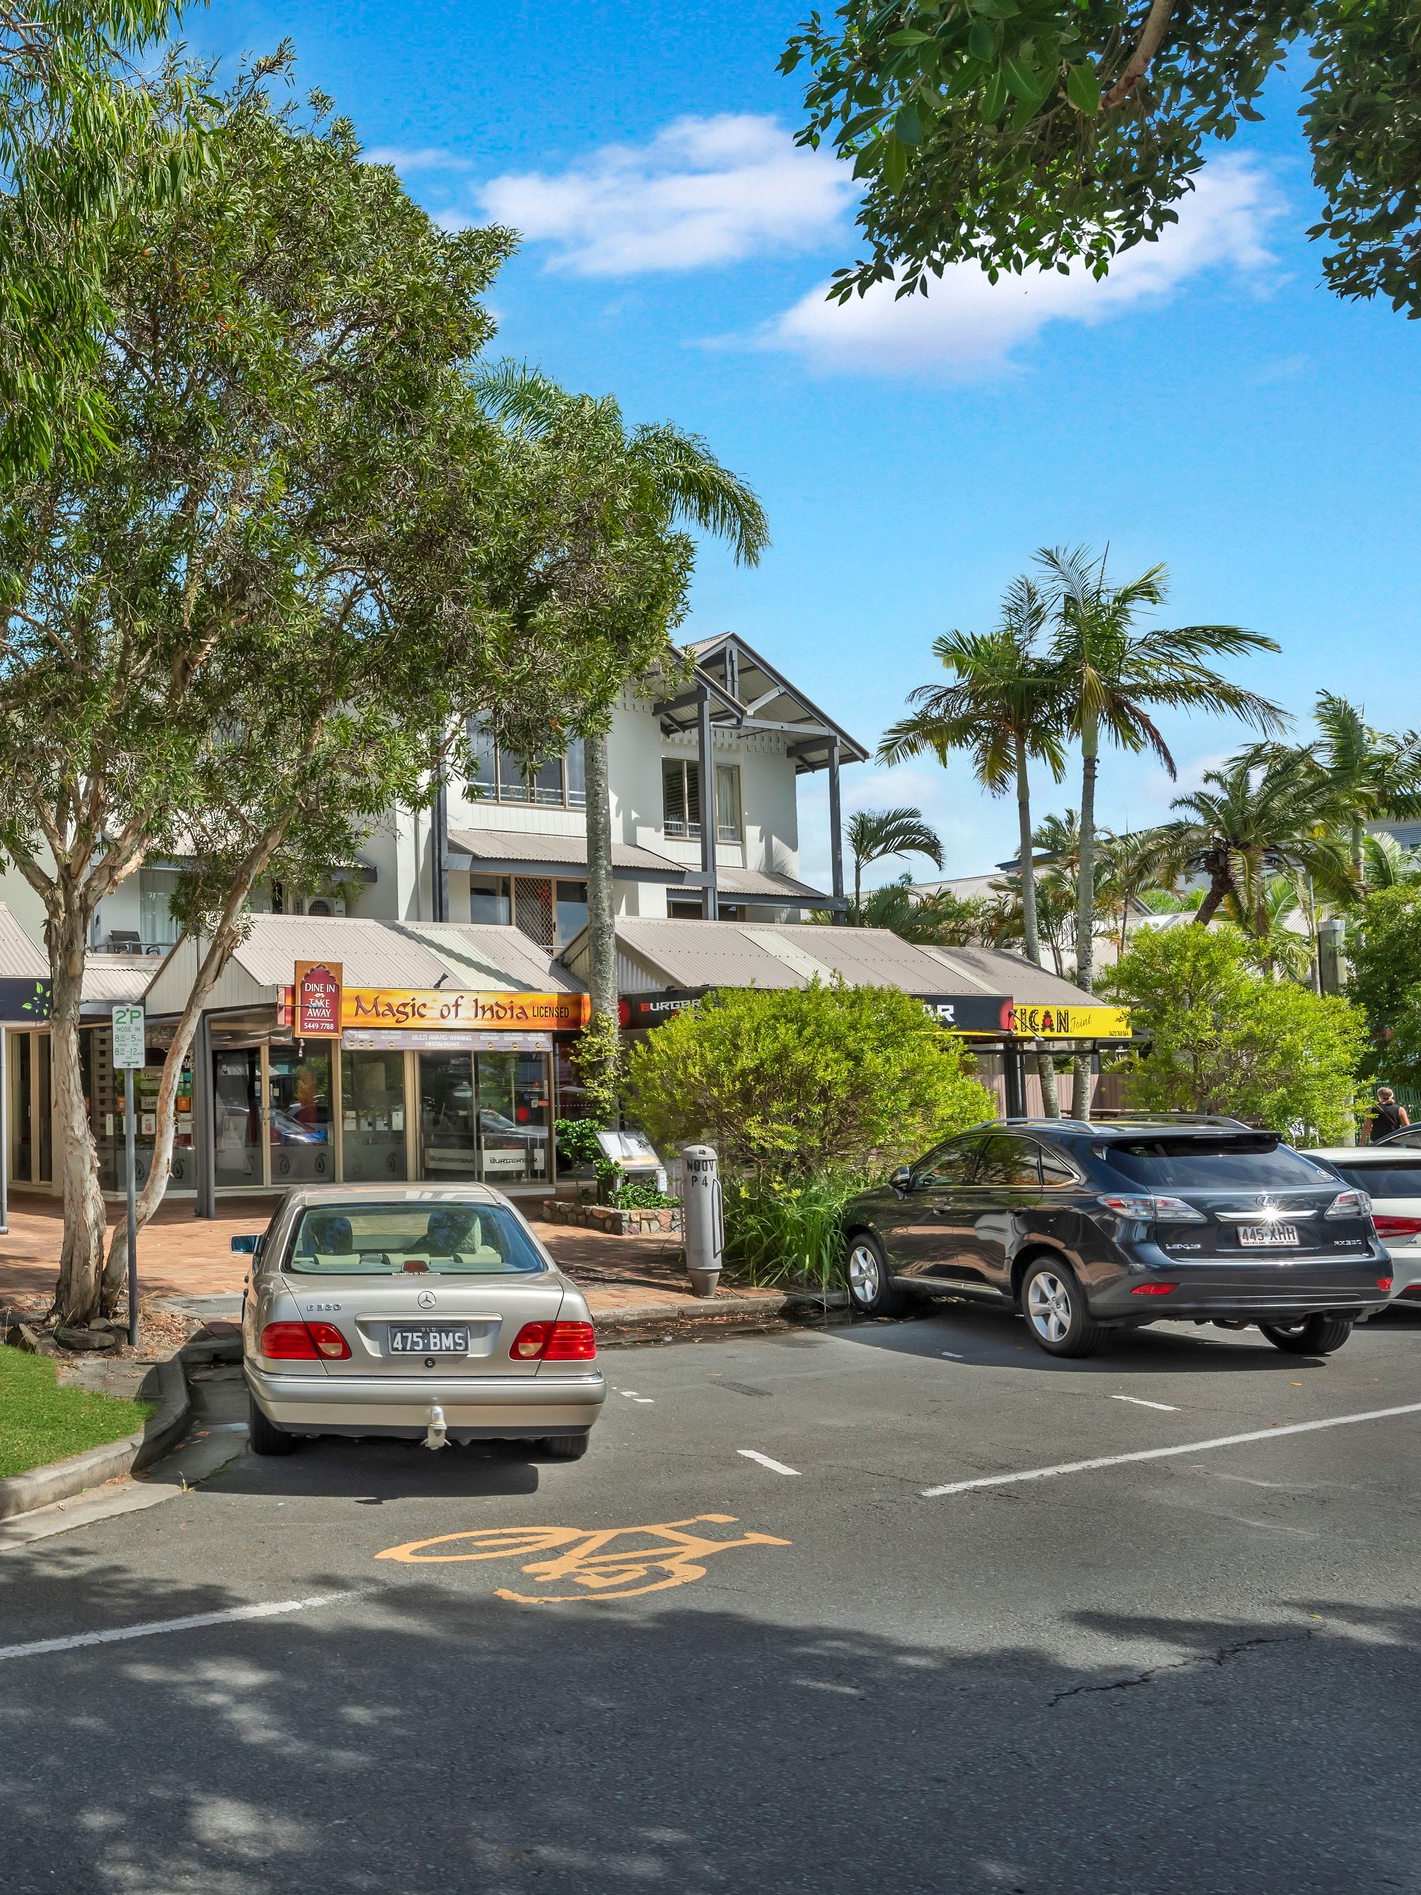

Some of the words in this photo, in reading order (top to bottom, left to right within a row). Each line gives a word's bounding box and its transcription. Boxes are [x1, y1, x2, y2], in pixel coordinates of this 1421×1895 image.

[304, 982, 324, 993] DINE
[326, 984, 336, 993] IN
[306, 1008, 332, 1018] AWAY
[354, 994, 427, 1024] Magic
[440, 994, 465, 1020] of
[473, 997, 530, 1021] India
[532, 1006, 570, 1019] LICENSED
[115, 1009, 142, 1025] 2P
[1014, 1008, 1070, 1033] ICAN
[303, 1022, 319, 1030] 5449
